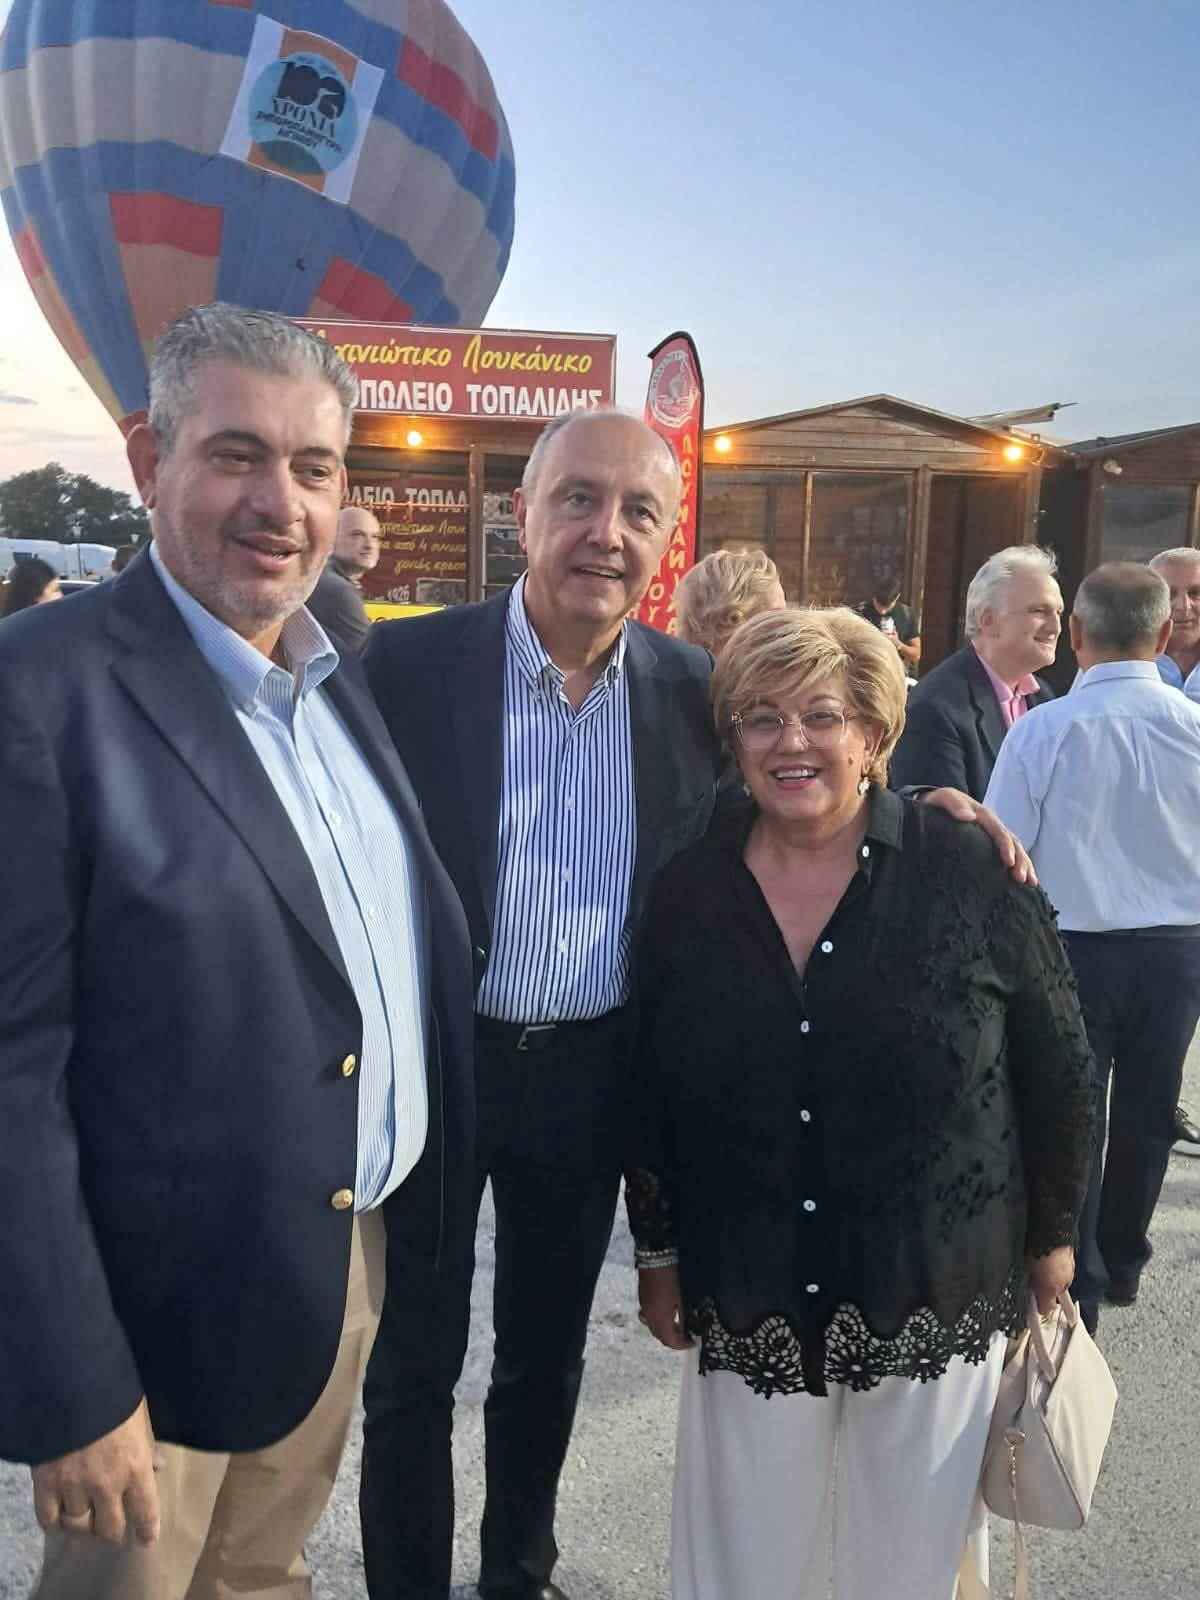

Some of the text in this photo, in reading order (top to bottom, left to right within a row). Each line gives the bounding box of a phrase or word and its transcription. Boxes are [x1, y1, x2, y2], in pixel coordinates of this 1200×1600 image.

[319, 330, 593, 374] γινιώτικο Λουκάνικο
[466, 384, 603, 417] ΤΟΠΑΛΙΔΗΣ
